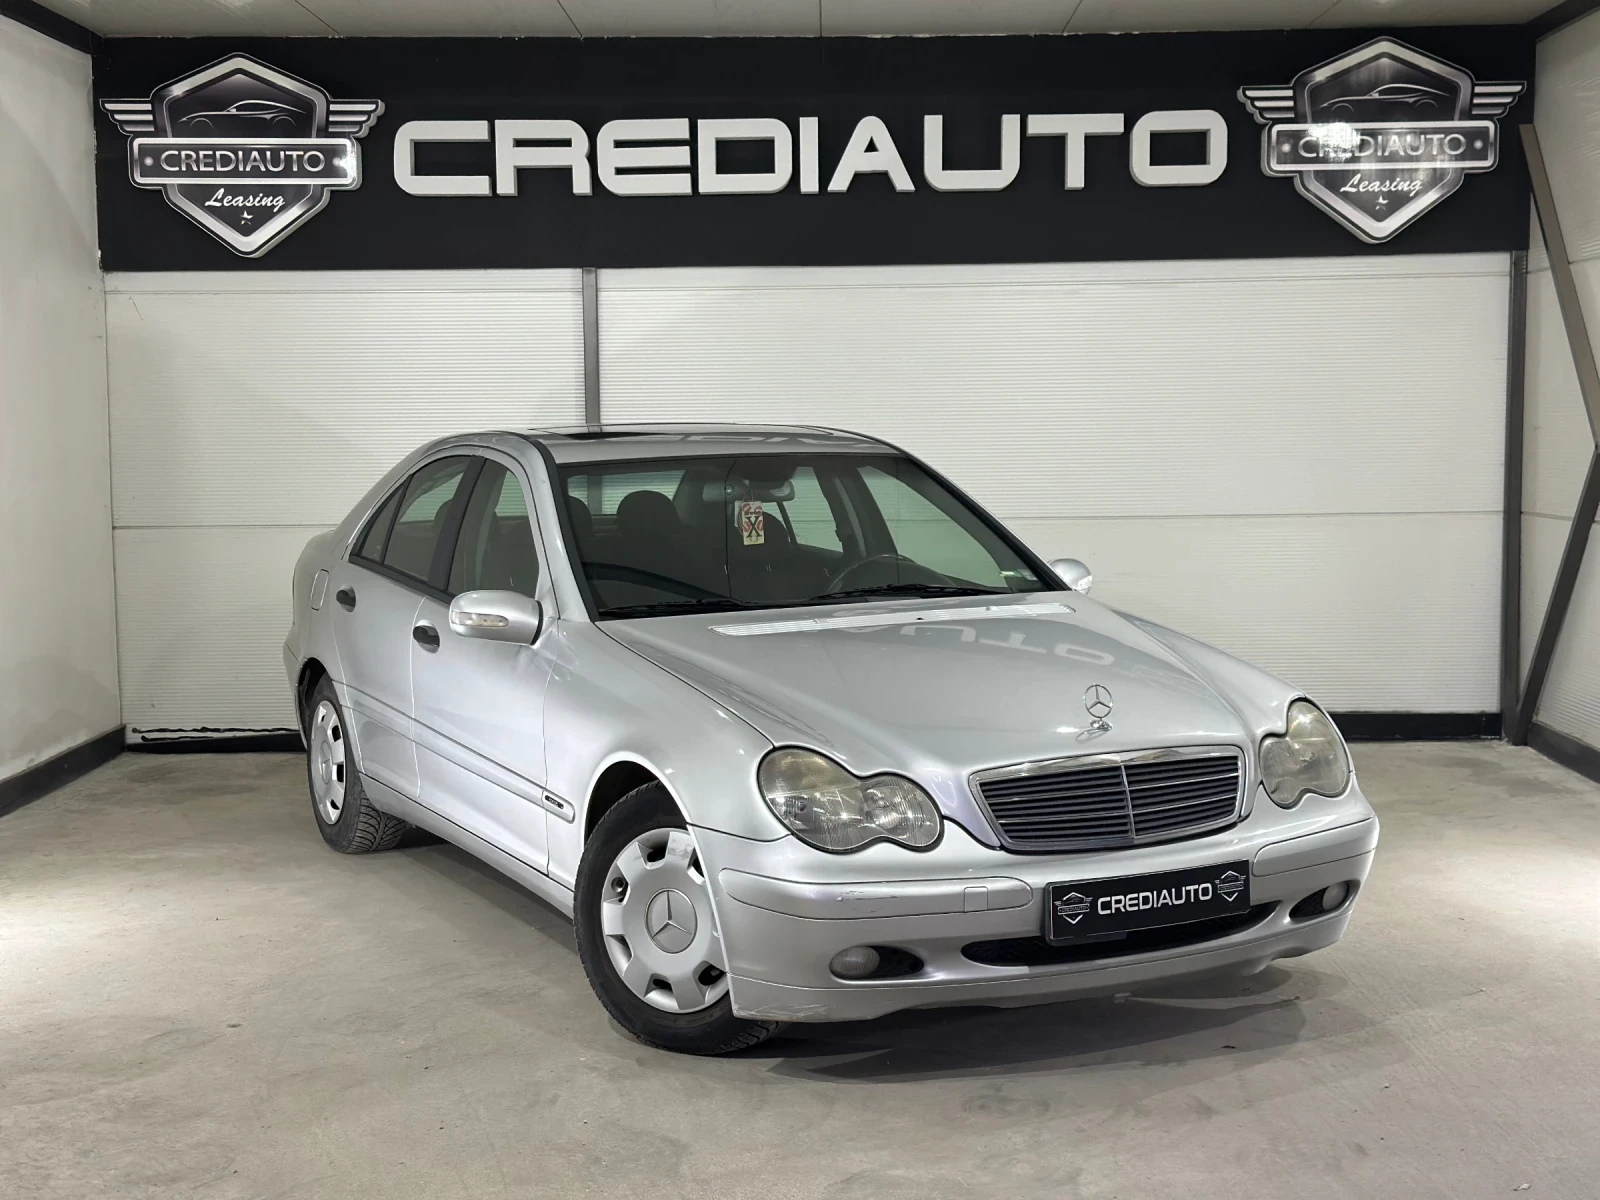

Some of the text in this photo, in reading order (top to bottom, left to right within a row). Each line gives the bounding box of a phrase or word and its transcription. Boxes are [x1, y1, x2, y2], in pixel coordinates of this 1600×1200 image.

[393, 109, 1229, 196] CREDIAUTO
[1298, 133, 1467, 158] CDIAUTO
[160, 150, 325, 173] CREDIAUTO
[1340, 173, 1423, 197] Leasing
[204, 188, 285, 213] Leasing
[1097, 883, 1213, 915] CREDIAUTO
